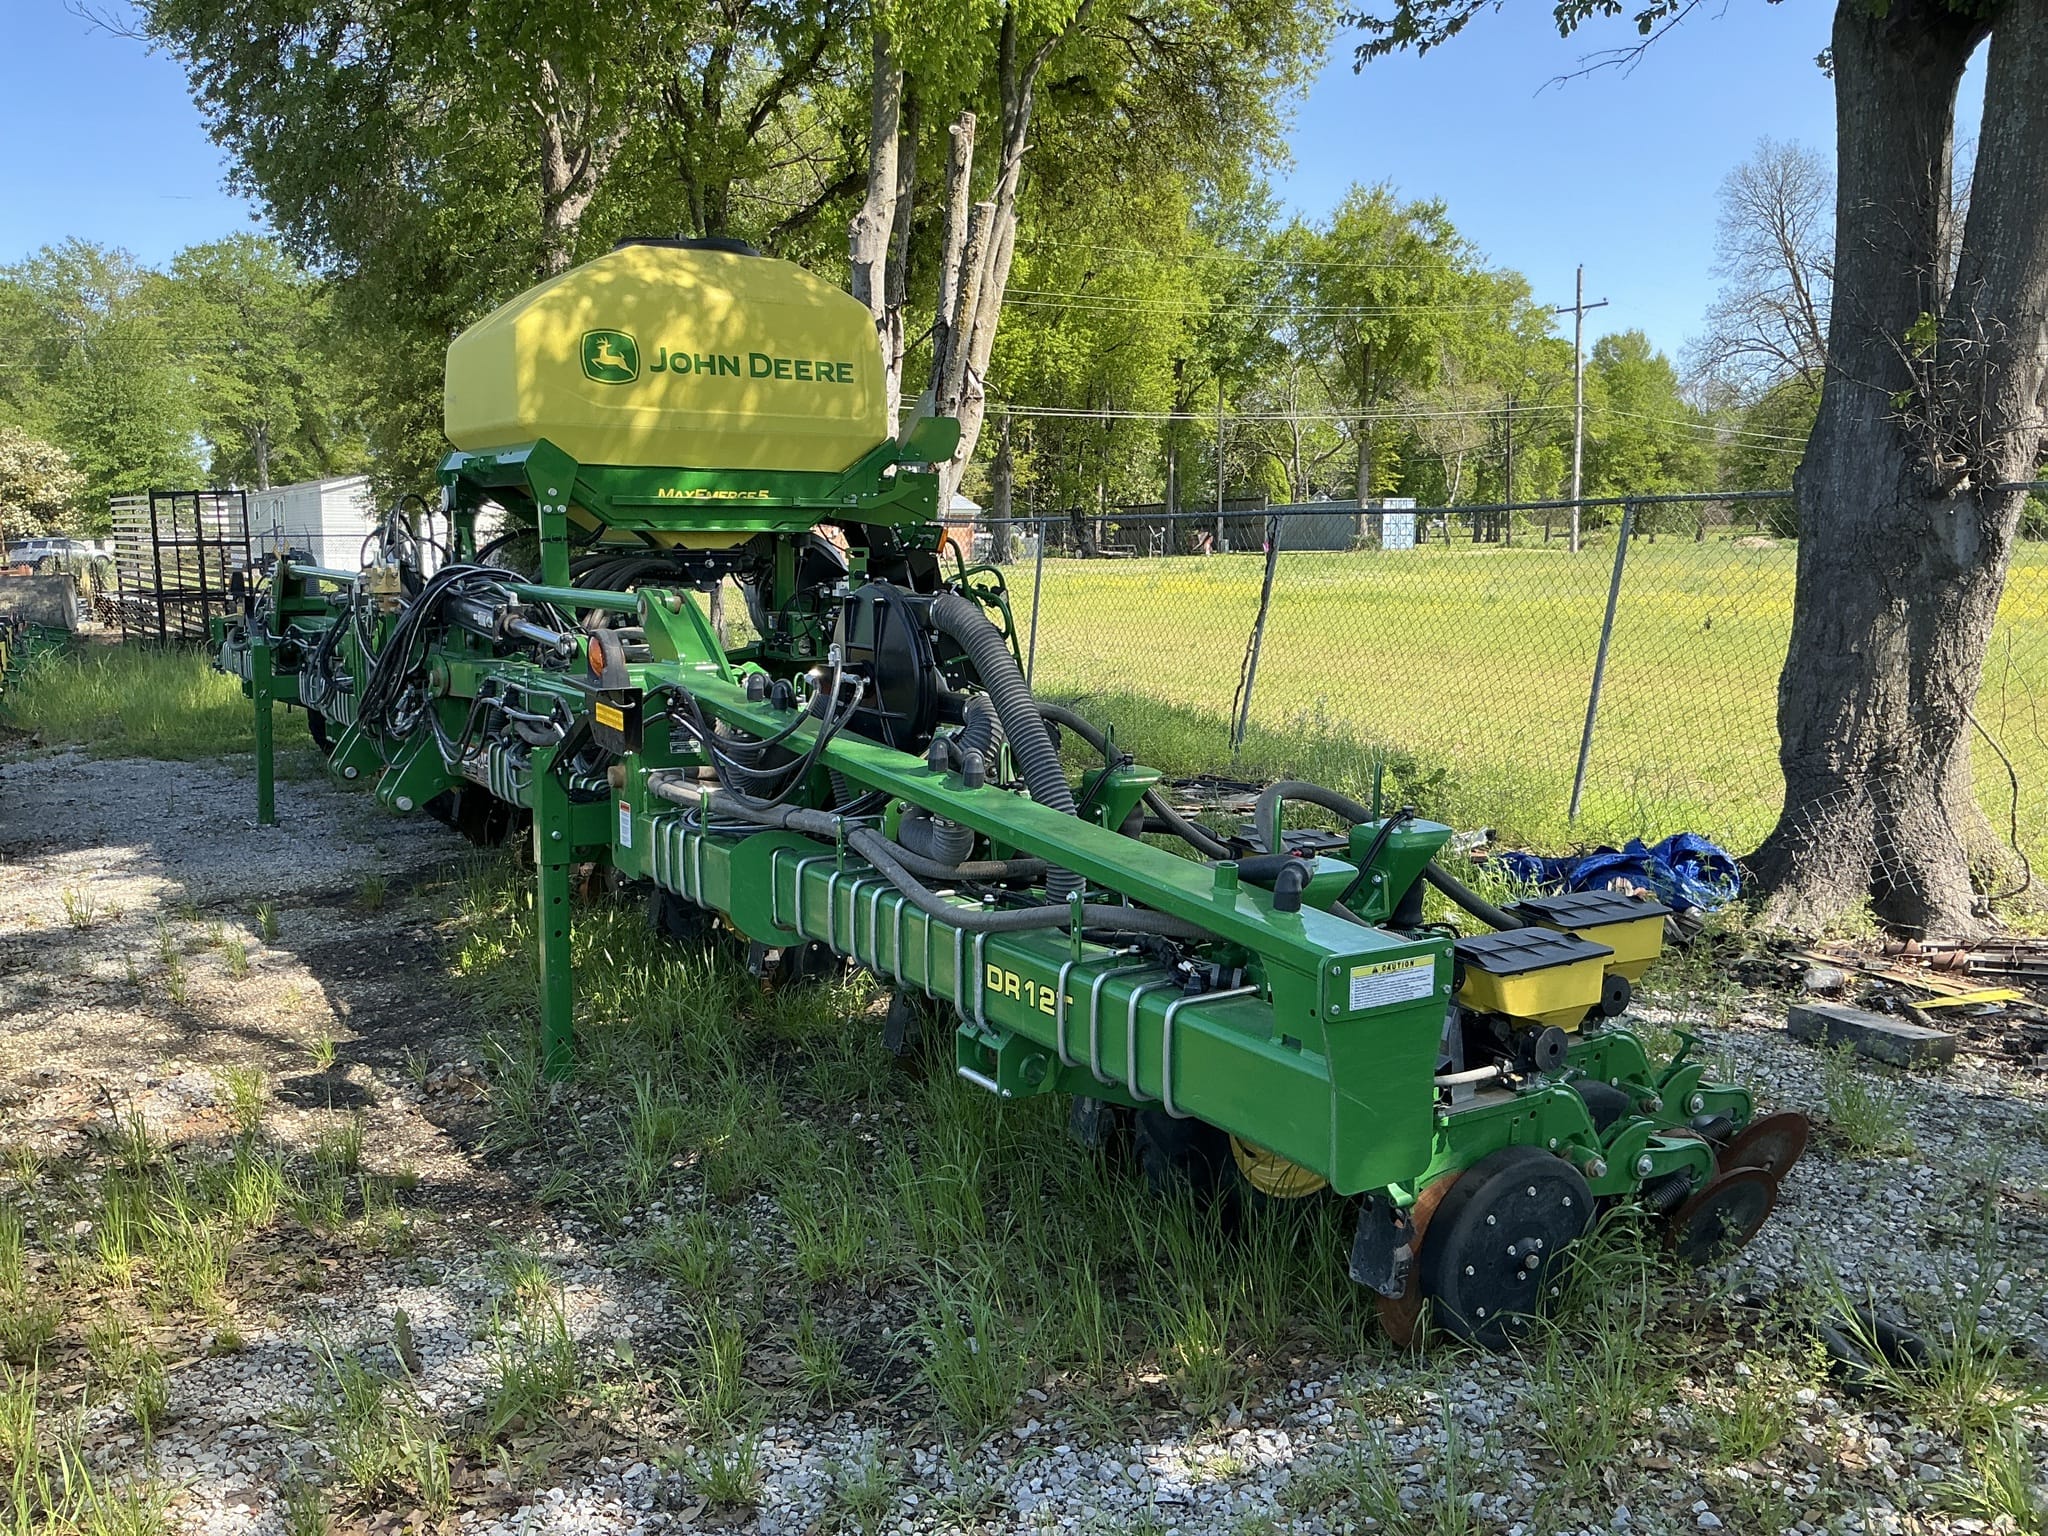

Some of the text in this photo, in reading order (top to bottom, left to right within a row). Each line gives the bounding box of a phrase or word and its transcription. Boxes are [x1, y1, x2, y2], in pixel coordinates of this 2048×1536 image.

[650, 347, 854, 383] JOHN DEERE
[1381, 960, 1415, 972] CAUTION
